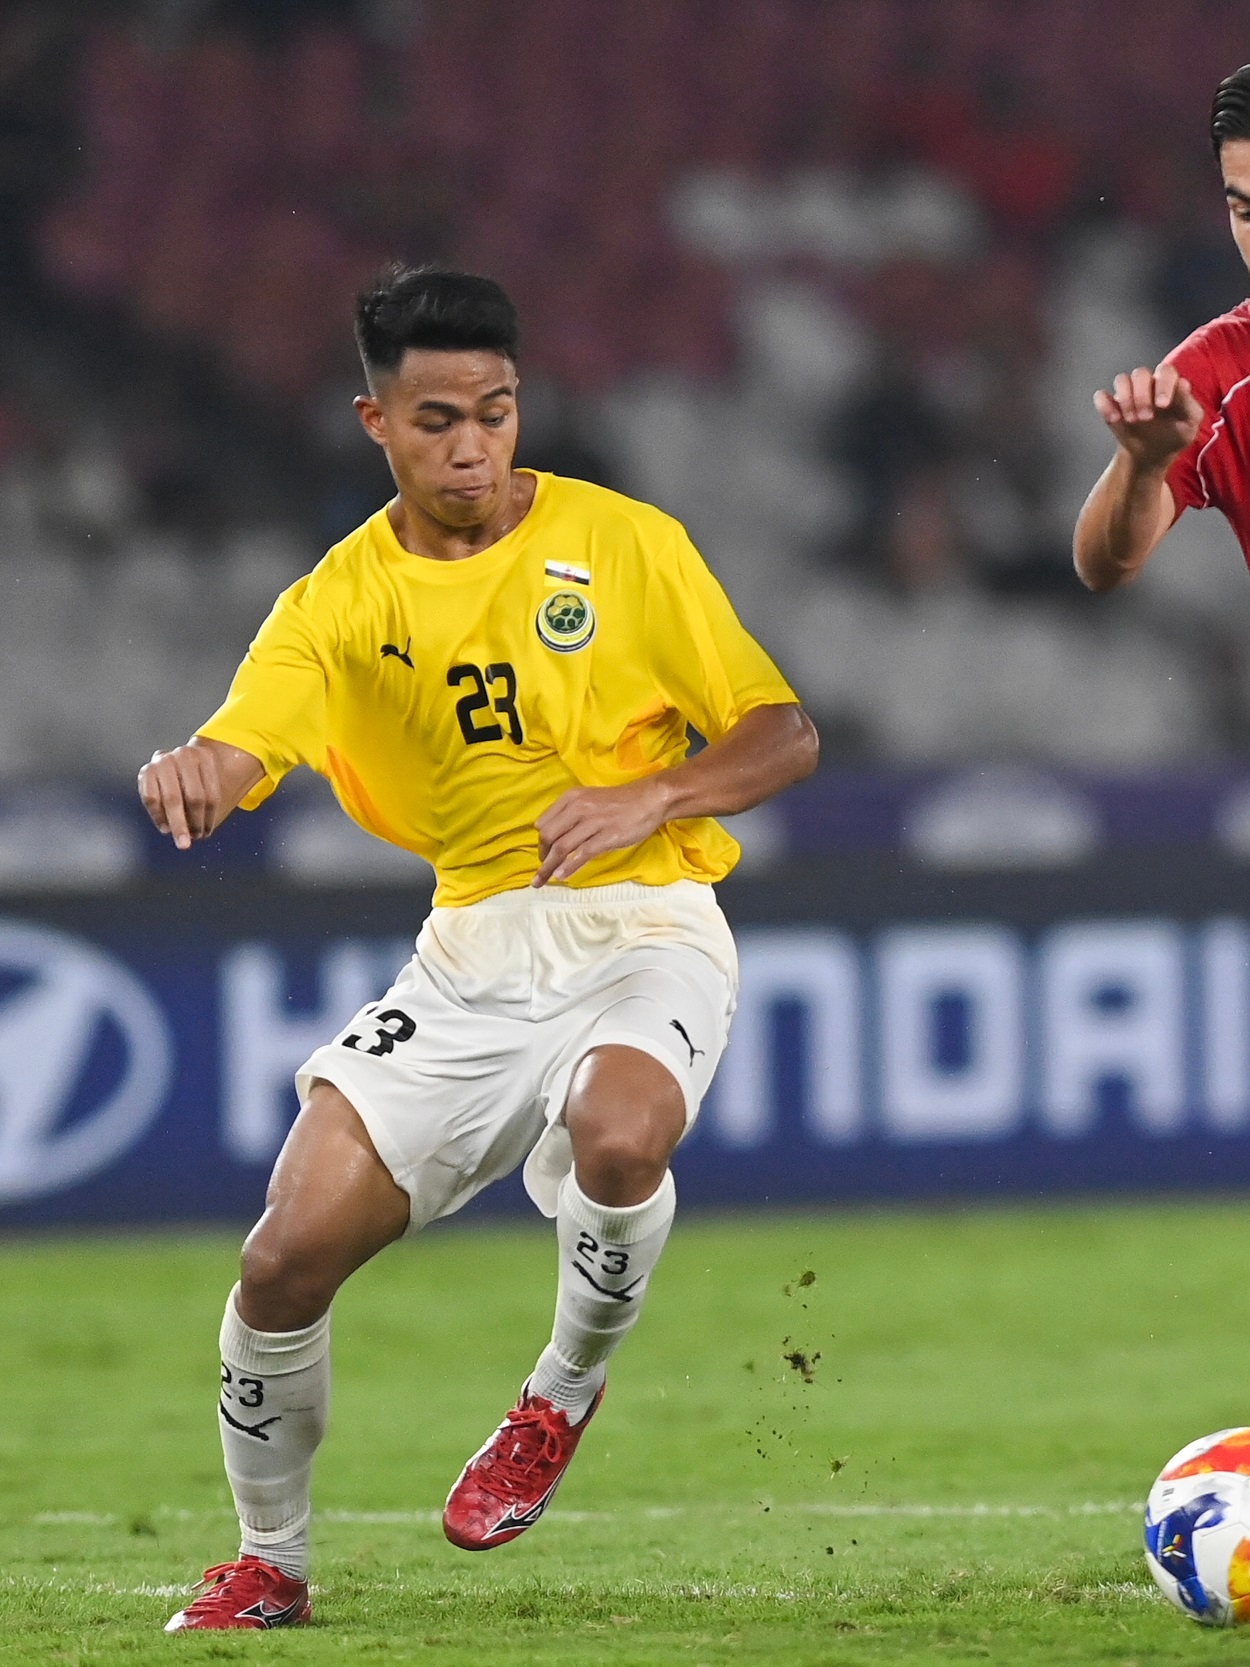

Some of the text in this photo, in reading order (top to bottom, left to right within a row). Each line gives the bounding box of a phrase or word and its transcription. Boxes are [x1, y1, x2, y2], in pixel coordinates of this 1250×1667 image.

[446, 662, 524, 746] 23
[342, 1006, 417, 1057] 3
[576, 1231, 630, 1275] 23
